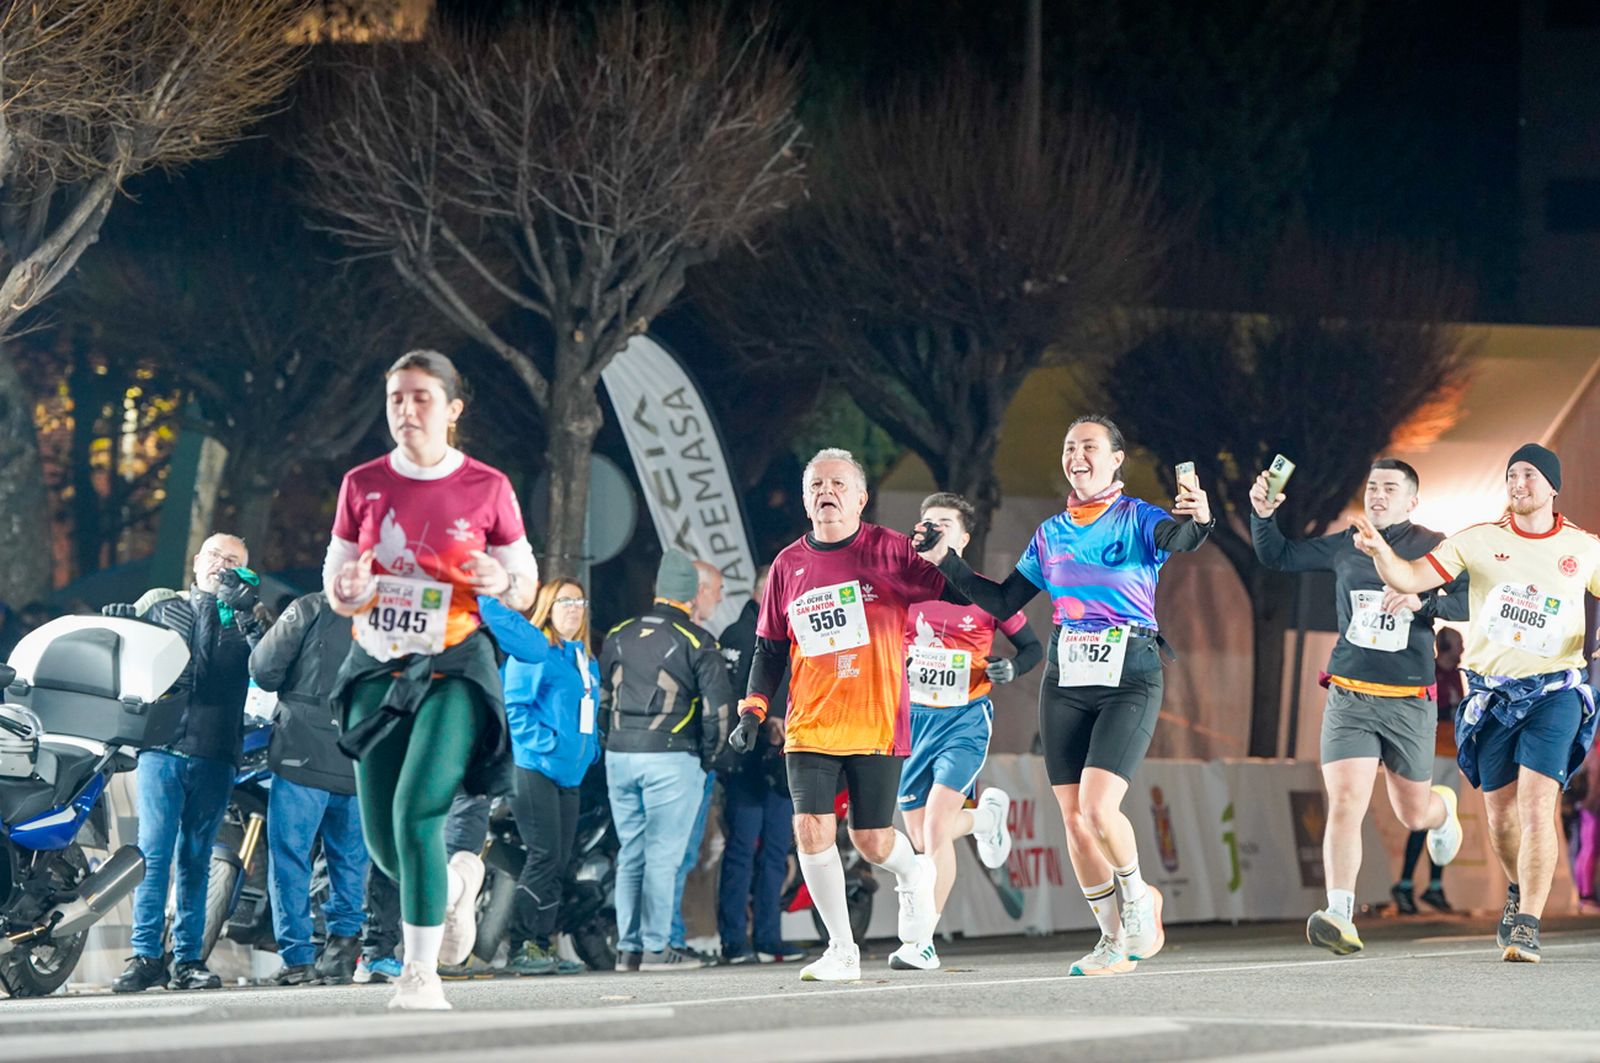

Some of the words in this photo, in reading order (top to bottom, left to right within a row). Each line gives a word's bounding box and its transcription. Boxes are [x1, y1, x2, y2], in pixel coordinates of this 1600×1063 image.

[662, 386, 752, 598] JAPEMASA
[391, 556, 415, 576] 43
[368, 607, 428, 633] 4945
[796, 605, 811, 616] SAN
[811, 600, 835, 612] ANTON
[808, 607, 847, 633] 556
[1500, 603, 1547, 628] 80085
[1362, 612, 1395, 631] 3213
[919, 667, 956, 687] 3210
[1008, 799, 1036, 840] AN
